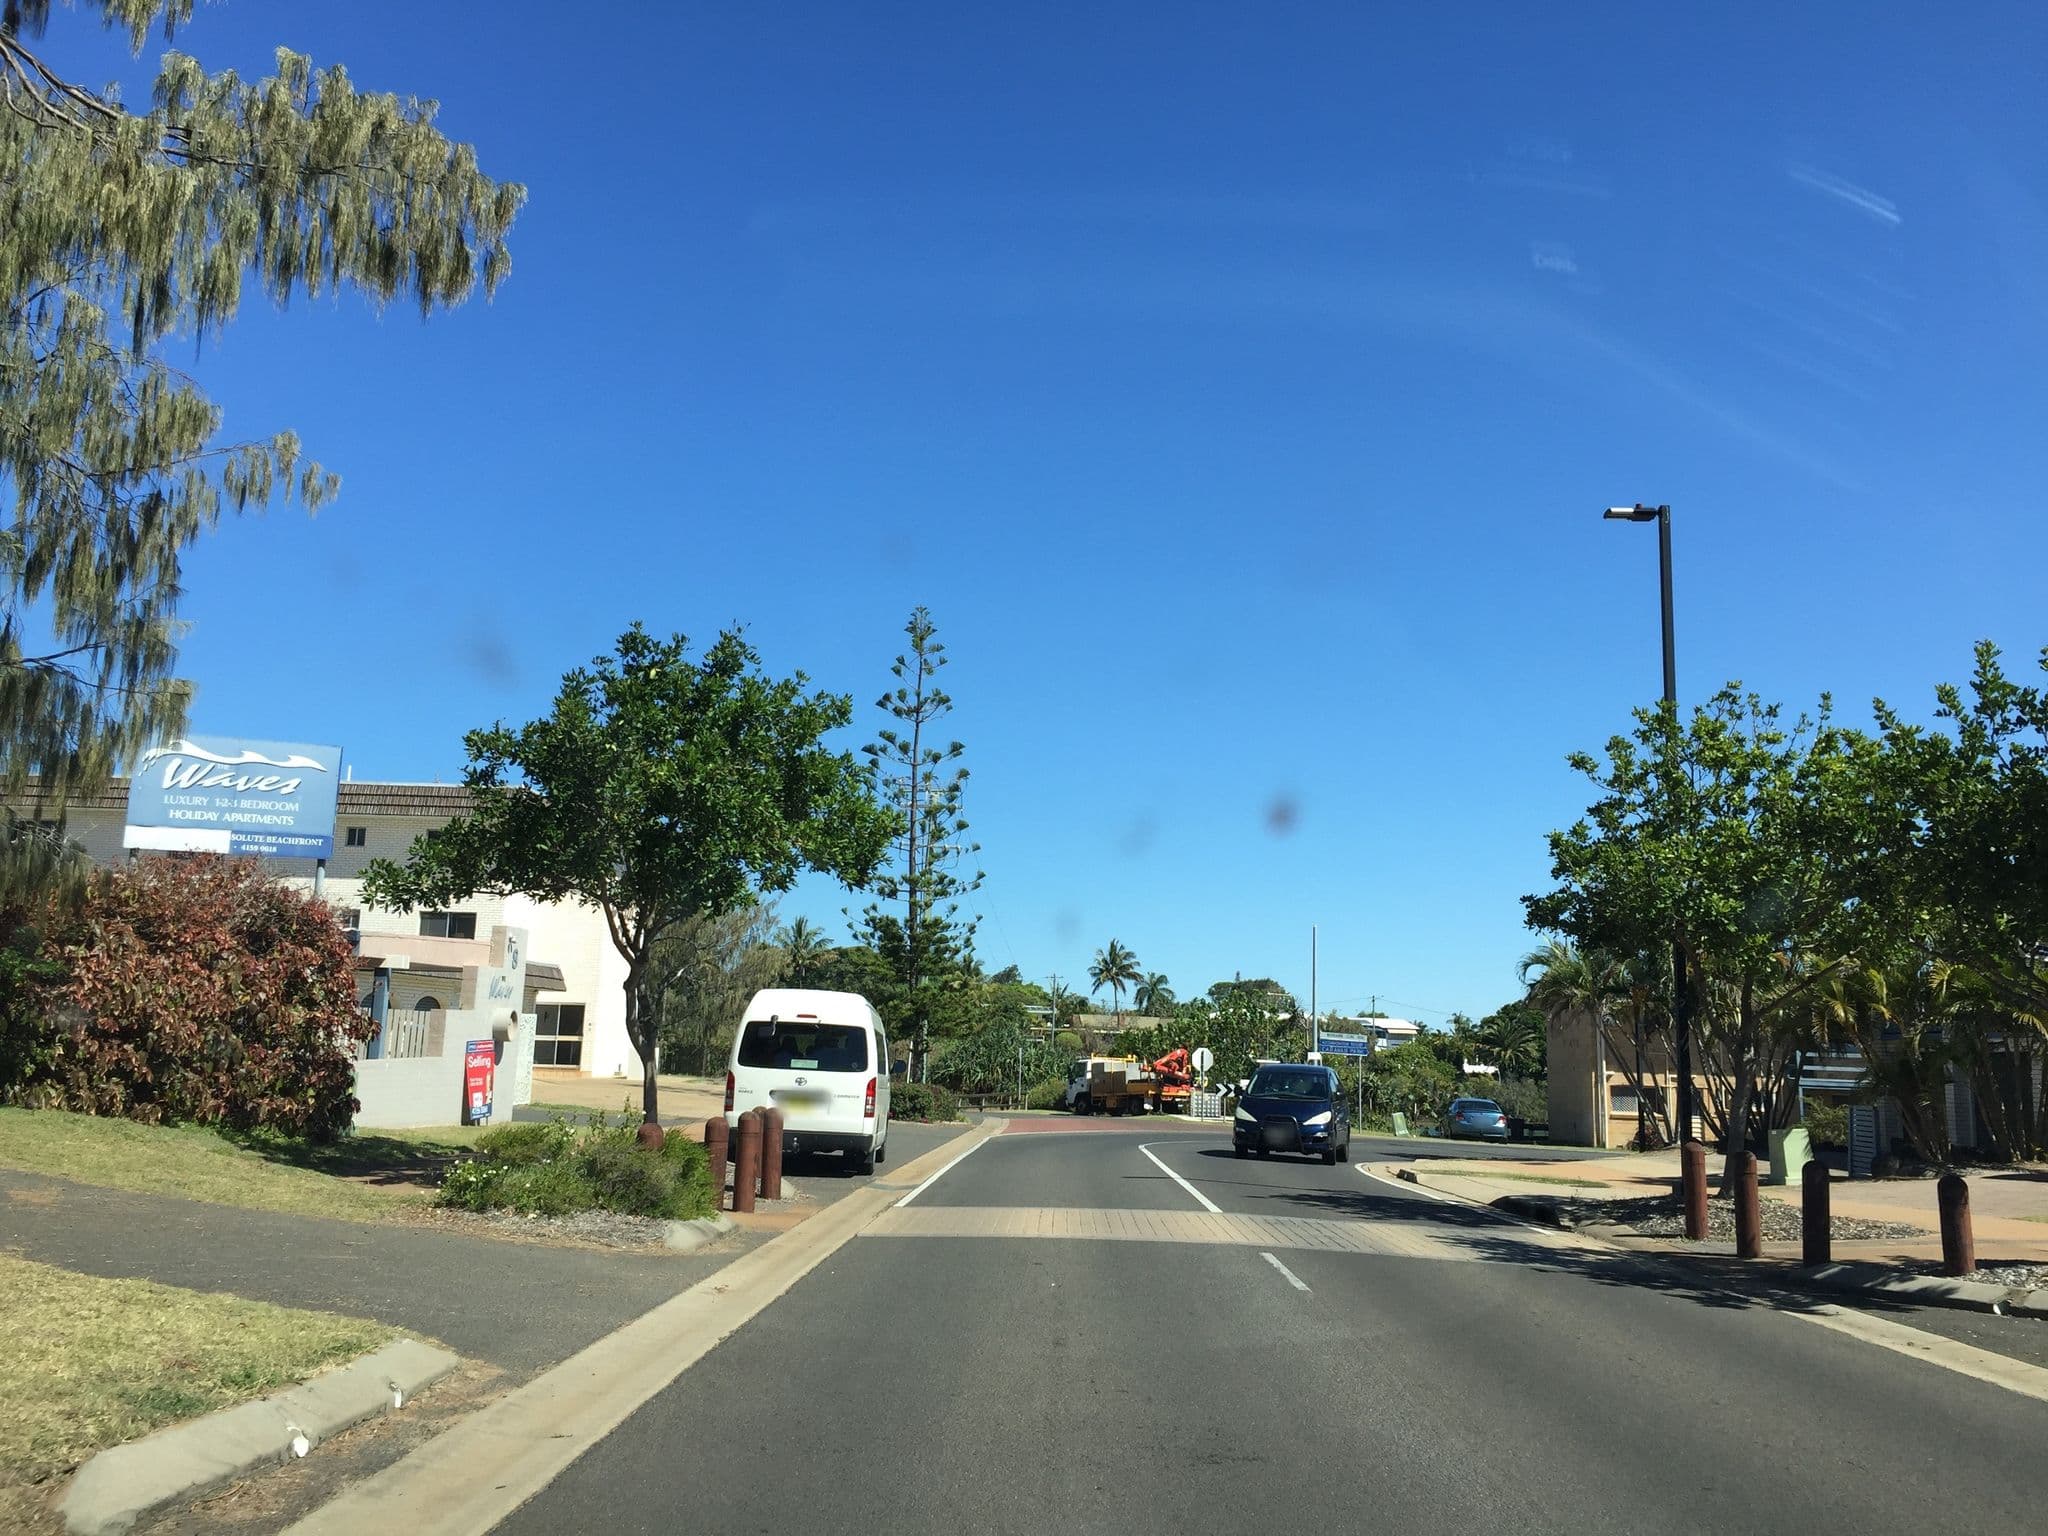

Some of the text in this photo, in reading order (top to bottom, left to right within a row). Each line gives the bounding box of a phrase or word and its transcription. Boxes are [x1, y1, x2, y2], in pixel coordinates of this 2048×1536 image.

[162, 758, 302, 796] Waves
[164, 796, 209, 806] LUXURY
[240, 800, 299, 812] BEDROOM
[169, 810, 294, 825] HOLIDAY APARTMENTS
[266, 837, 323, 846] BEACHFRONT
[468, 1055, 491, 1069] Selling
